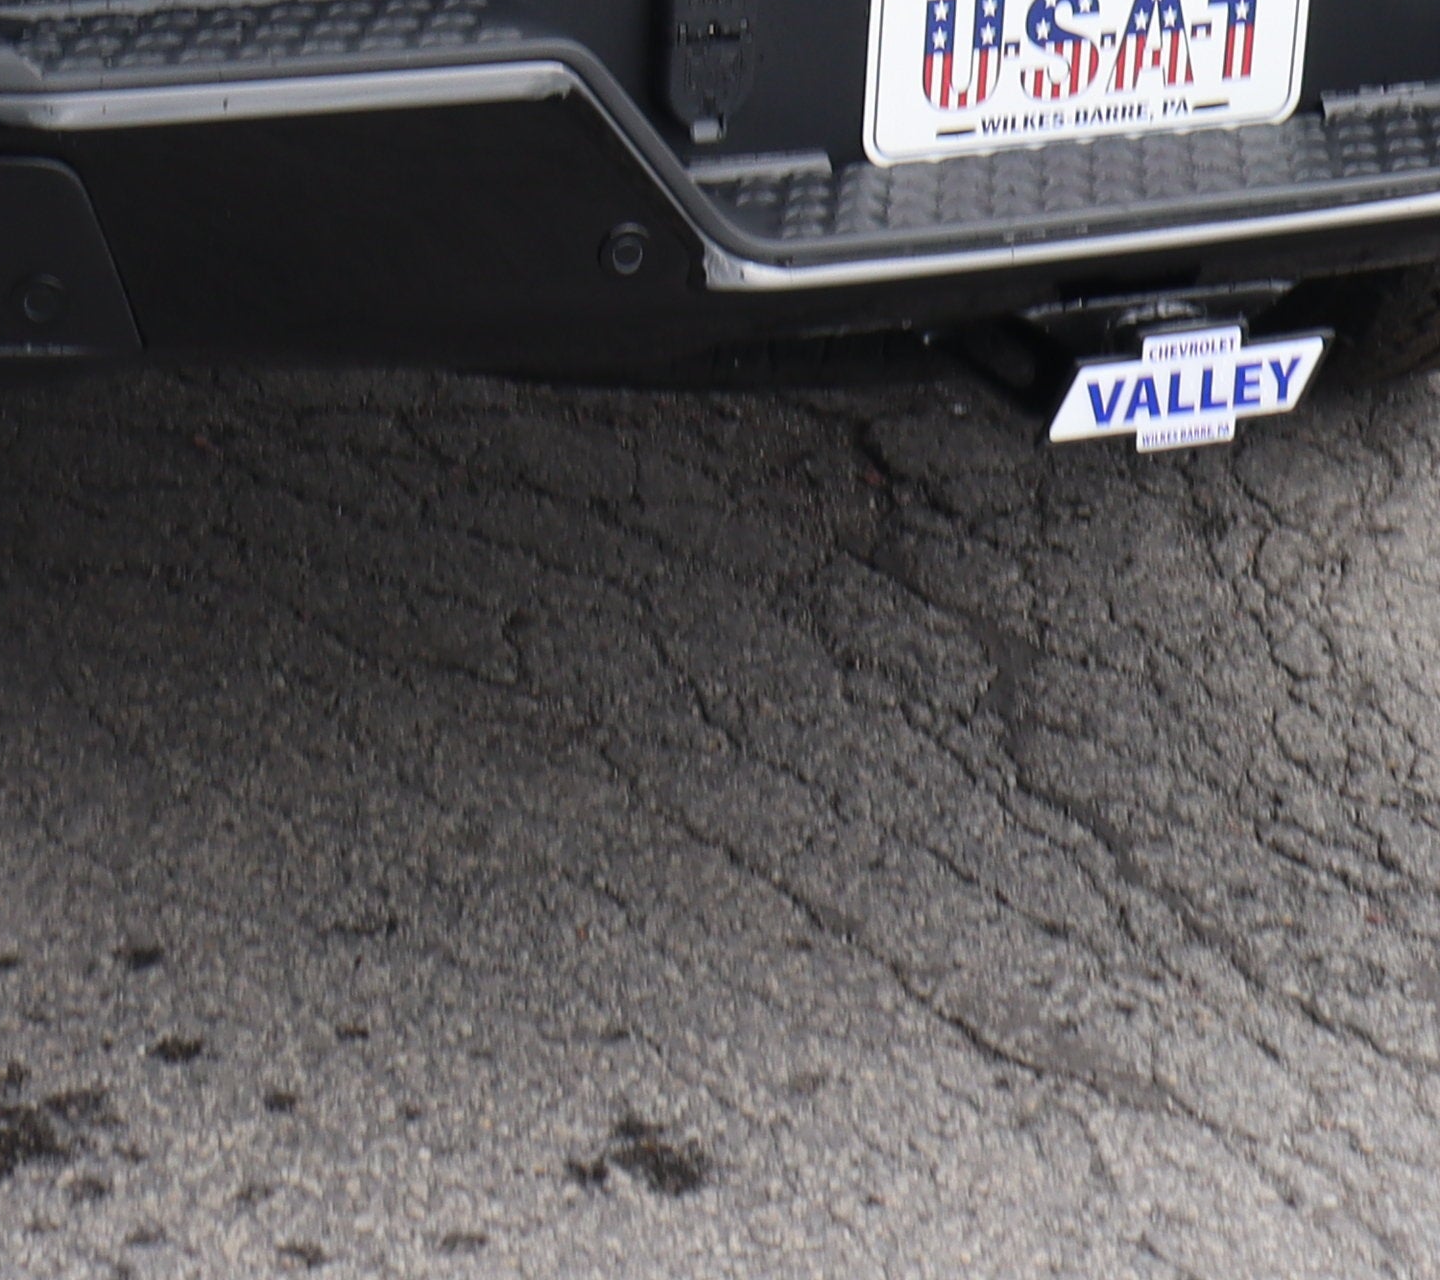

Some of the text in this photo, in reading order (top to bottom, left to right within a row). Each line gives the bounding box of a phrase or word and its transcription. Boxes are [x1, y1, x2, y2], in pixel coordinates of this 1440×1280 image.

[1162, 98, 1189, 116] PA
[1148, 337, 1236, 362] CHEVROLET
[1086, 356, 1301, 427] VALLEY
[1217, 423, 1231, 436] PA
